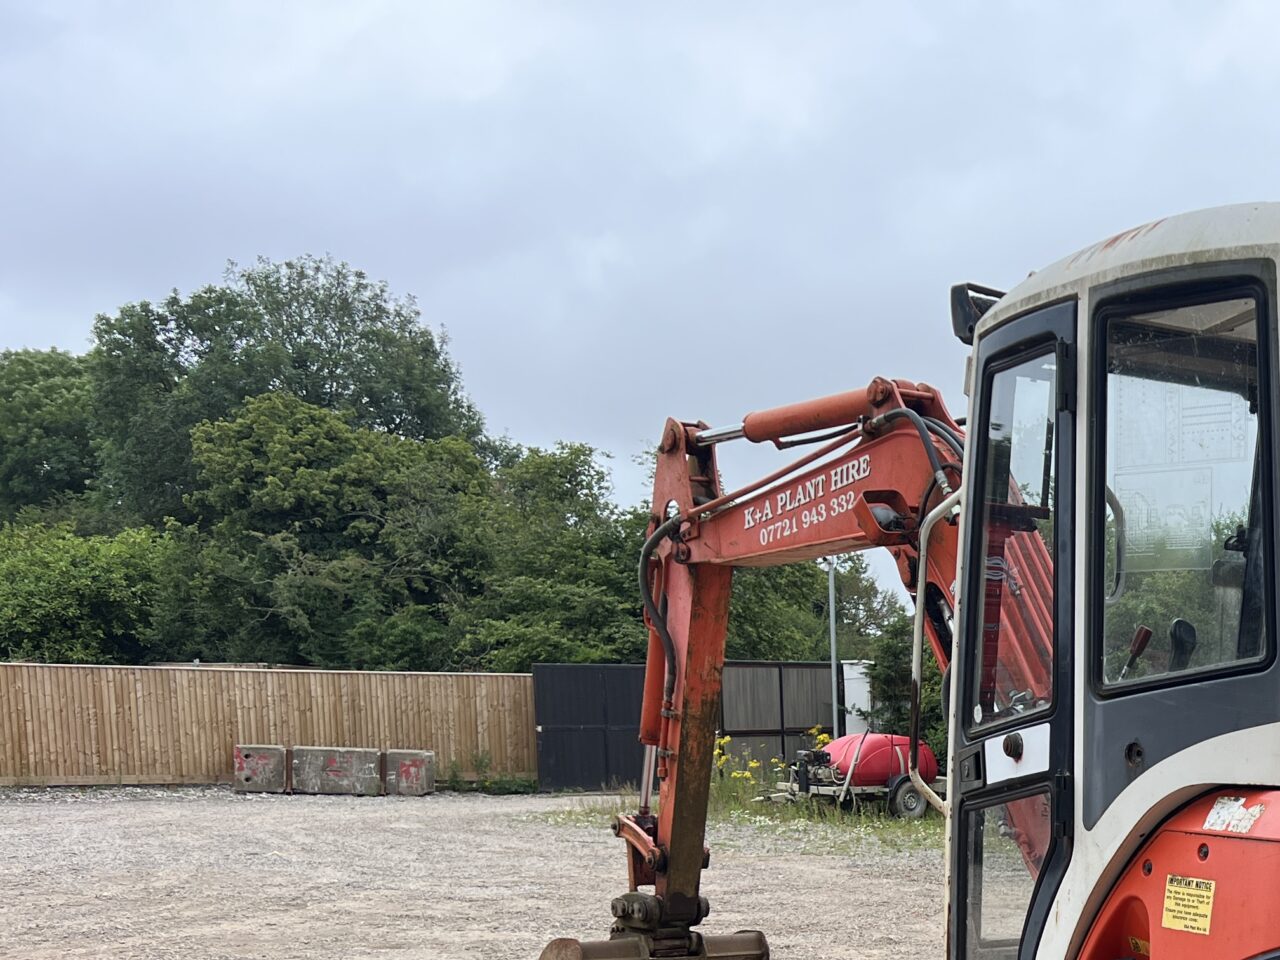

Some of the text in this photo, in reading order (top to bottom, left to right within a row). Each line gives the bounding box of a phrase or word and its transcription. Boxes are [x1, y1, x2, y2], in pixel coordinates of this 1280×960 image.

[744, 455, 871, 529] K+A PLANT HIRE
[759, 491, 855, 546] 07721 943 332
